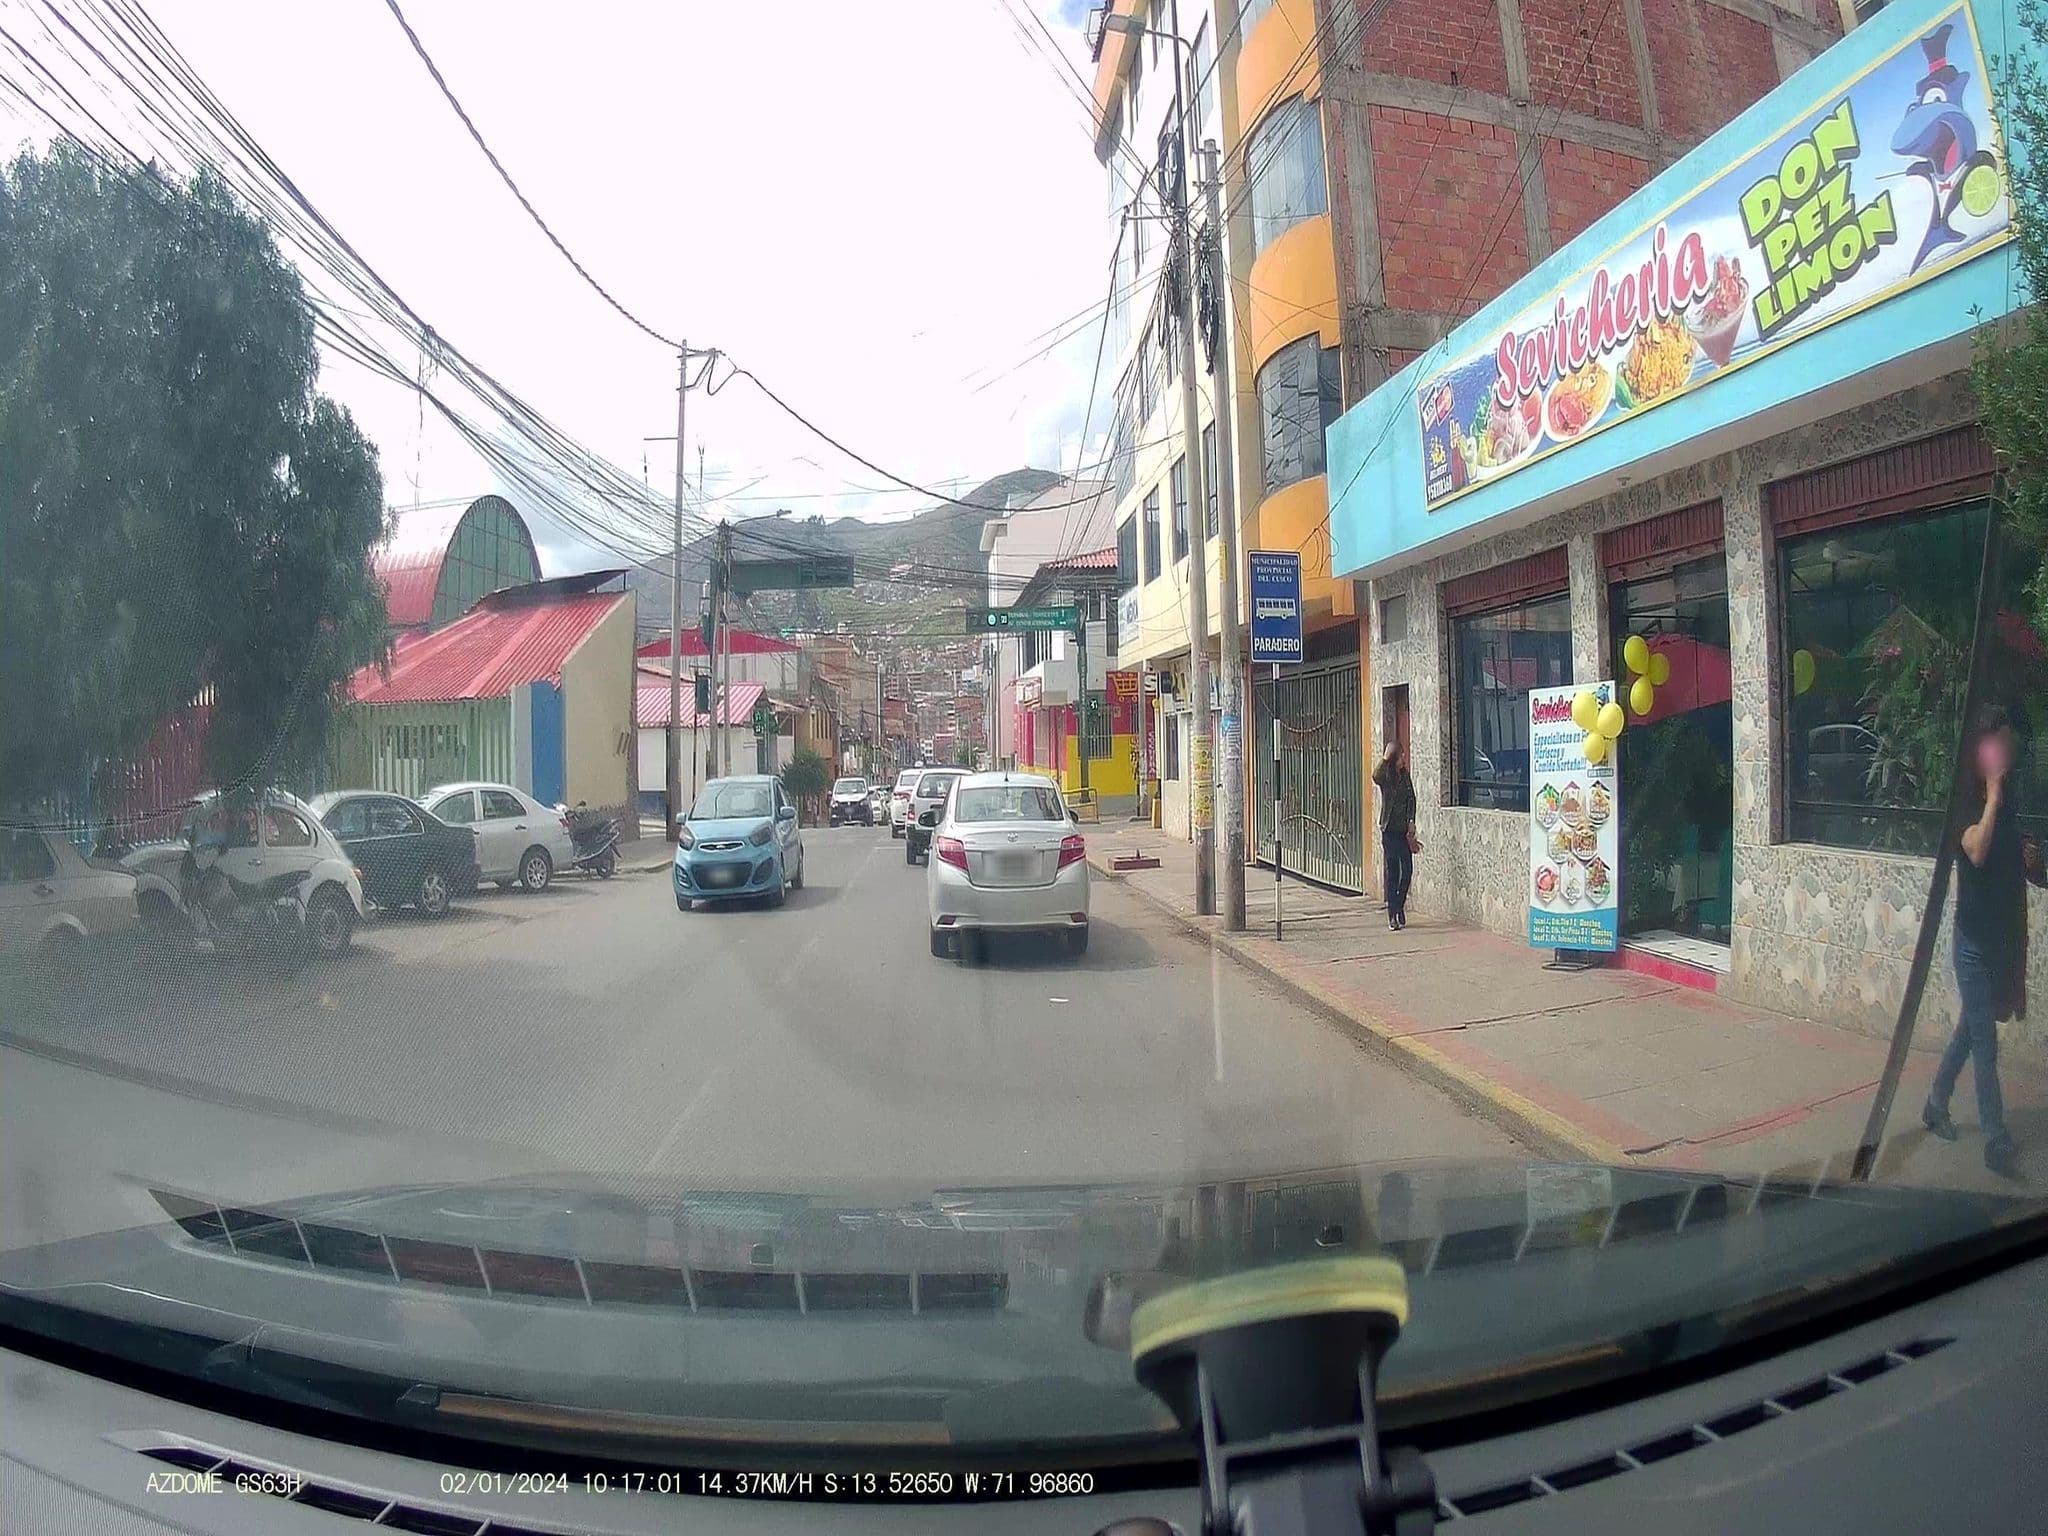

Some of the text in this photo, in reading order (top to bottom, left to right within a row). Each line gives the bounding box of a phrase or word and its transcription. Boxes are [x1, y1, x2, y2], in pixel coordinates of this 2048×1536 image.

[1739, 97, 1859, 244] DON
[1763, 164, 1855, 277] PEZ
[1753, 190, 1896, 337] LIMON
[1496, 224, 1710, 405] Sevicheria
[1252, 557, 1298, 566] MUNICIPALIDAD
[1256, 566, 1292, 574] PROVINCIAL
[1258, 575, 1292, 583] DEL CUSCO
[1254, 637, 1300, 652] PARADERO
[1531, 693, 1573, 725] Seviche
